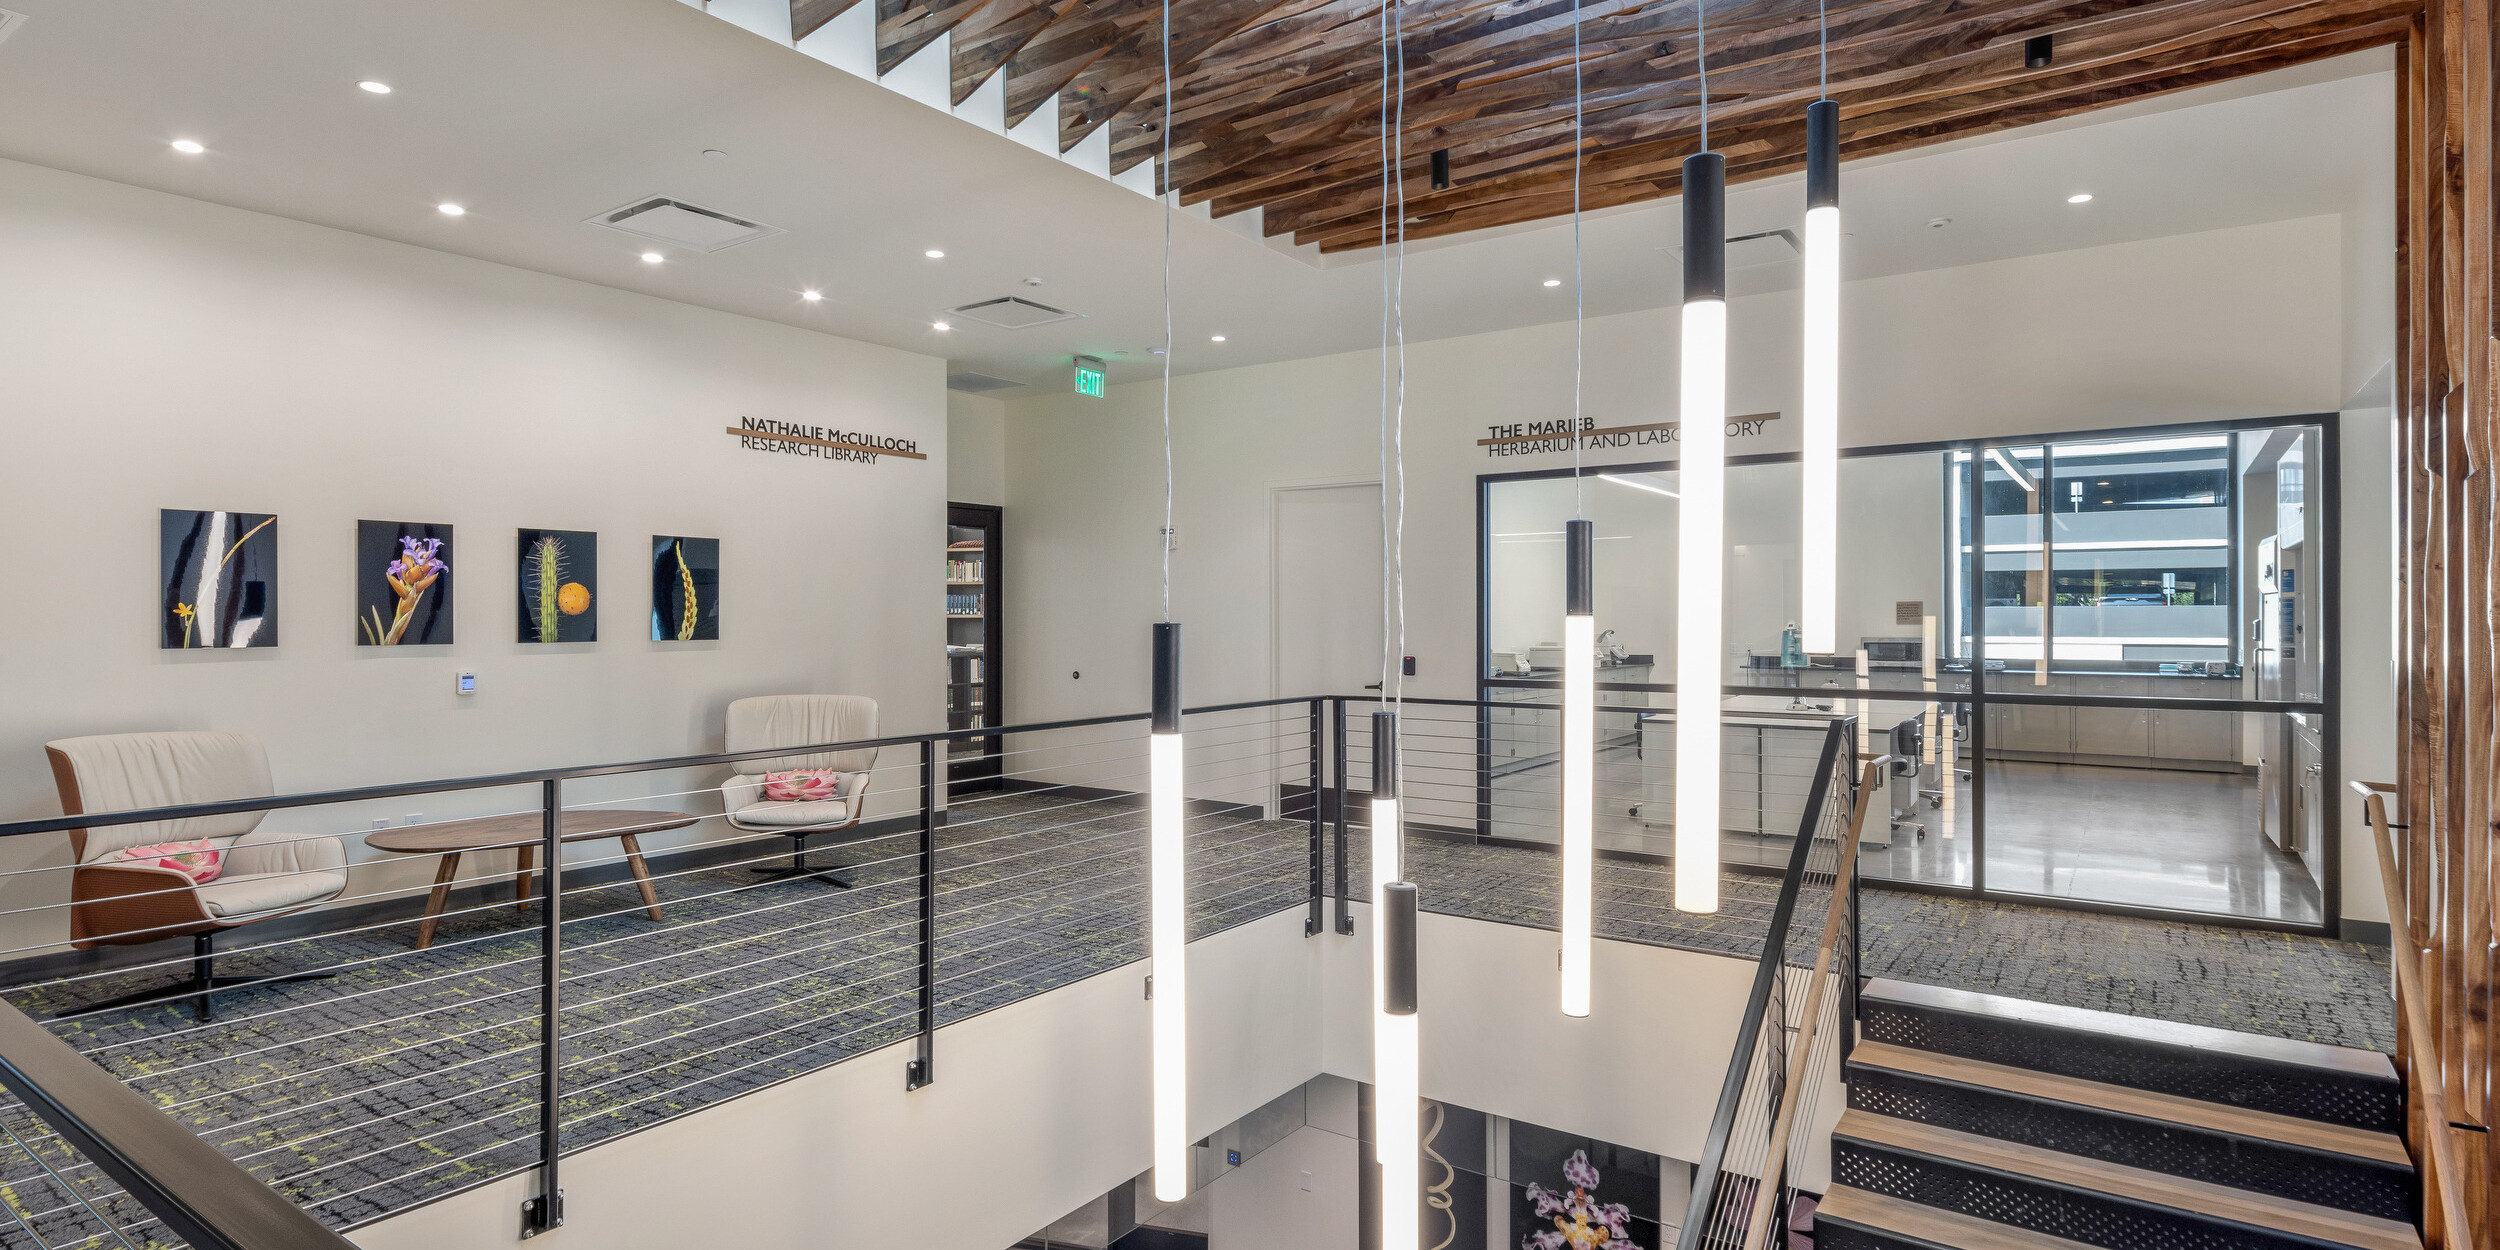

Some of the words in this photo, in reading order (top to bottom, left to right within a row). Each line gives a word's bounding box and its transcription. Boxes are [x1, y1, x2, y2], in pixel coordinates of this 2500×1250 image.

[1080, 369, 1101, 396] EXIT
[742, 415, 823, 440] NATHALIE
[828, 429, 916, 453] McCULLOCH
[1488, 424, 1522, 439] THE
[1529, 416, 1595, 436] MARIEB
[1489, 437, 1584, 457] HERBARIUM
[1590, 431, 1631, 449] AND
[1637, 419, 1765, 445] LABOORY
[741, 435, 819, 458] RESEARCH
[824, 446, 878, 465] LIBRARY
